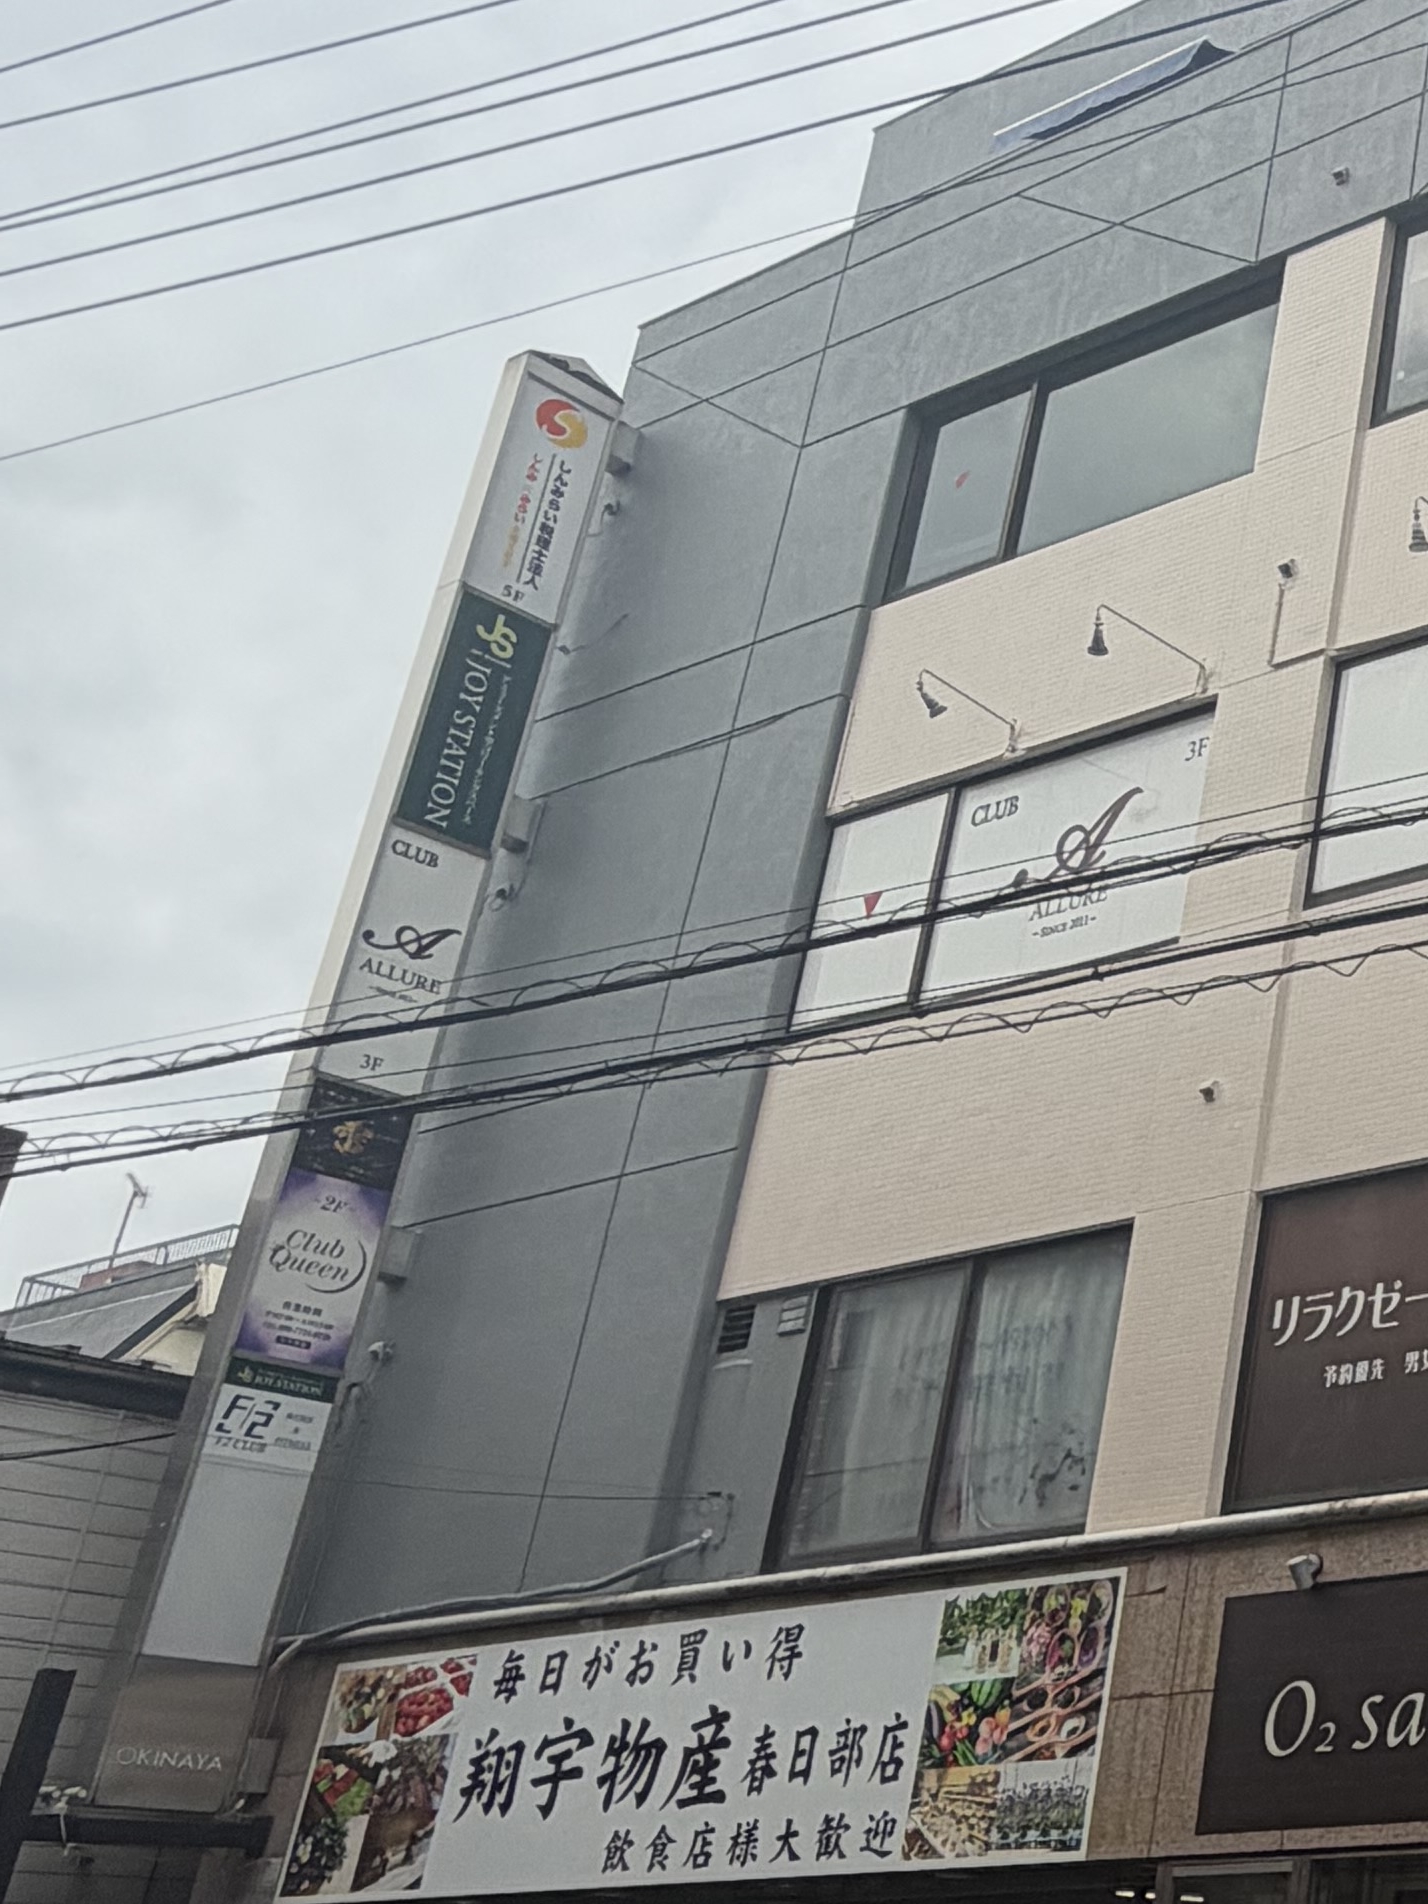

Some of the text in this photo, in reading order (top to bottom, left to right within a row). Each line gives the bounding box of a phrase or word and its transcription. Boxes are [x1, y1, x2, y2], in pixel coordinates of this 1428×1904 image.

[459, 654, 493, 713] JOY
[1184, 736, 1210, 763] 3F
[424, 709, 476, 828] STATION
[970, 795, 1019, 828] CLUB
[391, 839, 440, 868] CLUB
[359, 957, 442, 995] ALLURE
[360, 1054, 384, 1072] 3F
[286, 1228, 345, 1260] Club
[269, 1244, 350, 1283] Queen
[1323, 1357, 1385, 1388] 予約優先
[491, 1623, 806, 1704] 毎日がお買い得
[117, 1747, 222, 1771] OKINAYA
[600, 1810, 898, 1875] 飲食店様大歓迎
